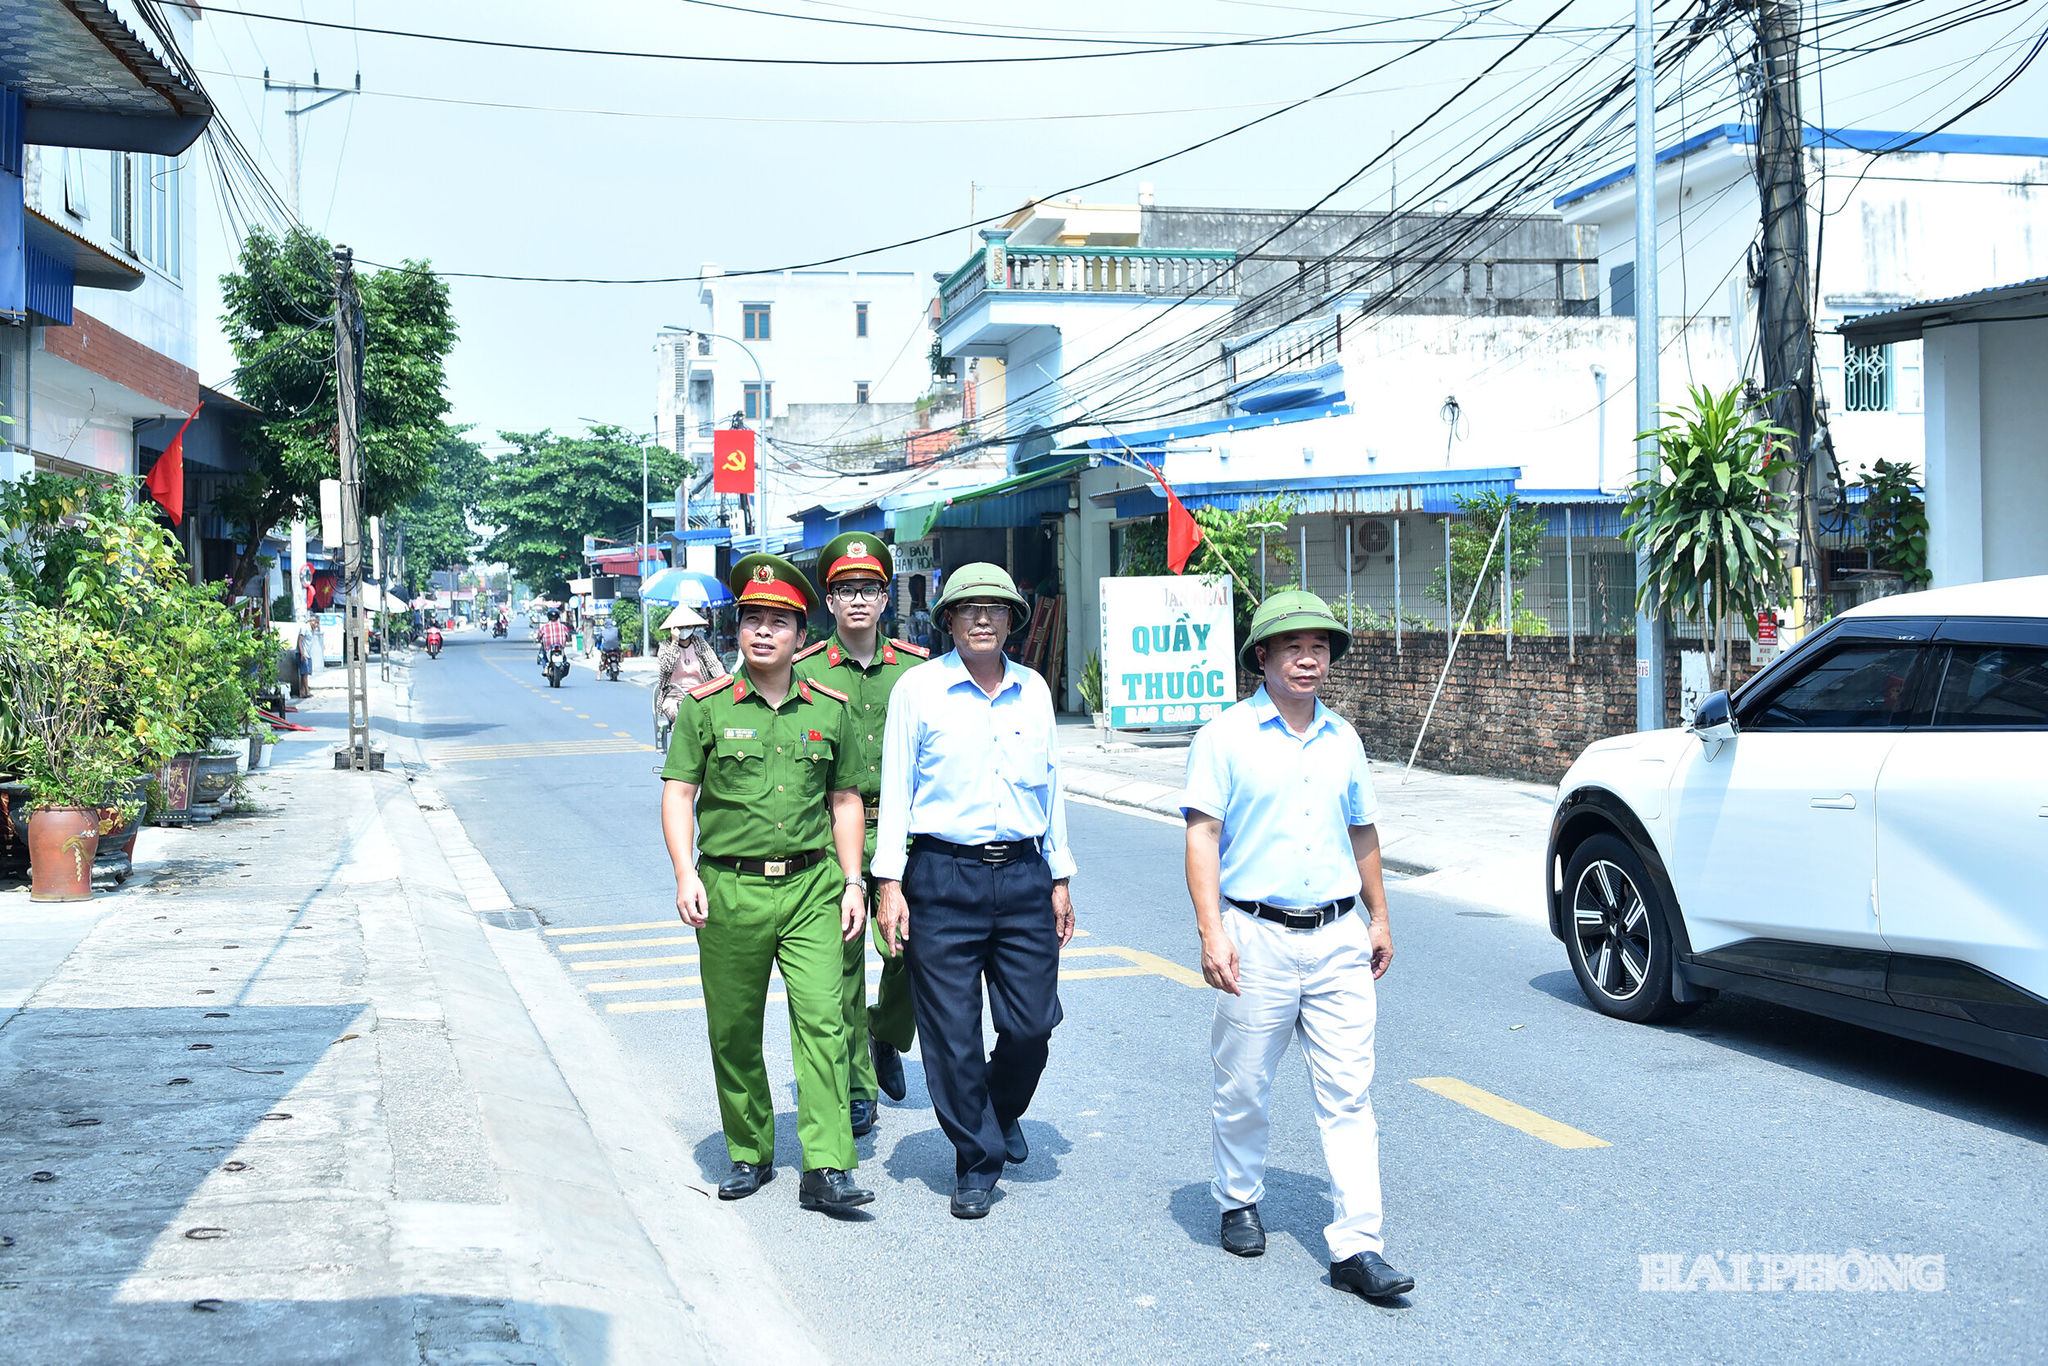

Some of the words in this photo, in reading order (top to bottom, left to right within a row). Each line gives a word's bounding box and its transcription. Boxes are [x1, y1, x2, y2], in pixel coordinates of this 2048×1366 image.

[1132, 612, 1211, 656] QUẦY
[1122, 659, 1223, 701] THUỐC
[1125, 706, 1159, 724] BAO
[1162, 704, 1196, 723] CAO
